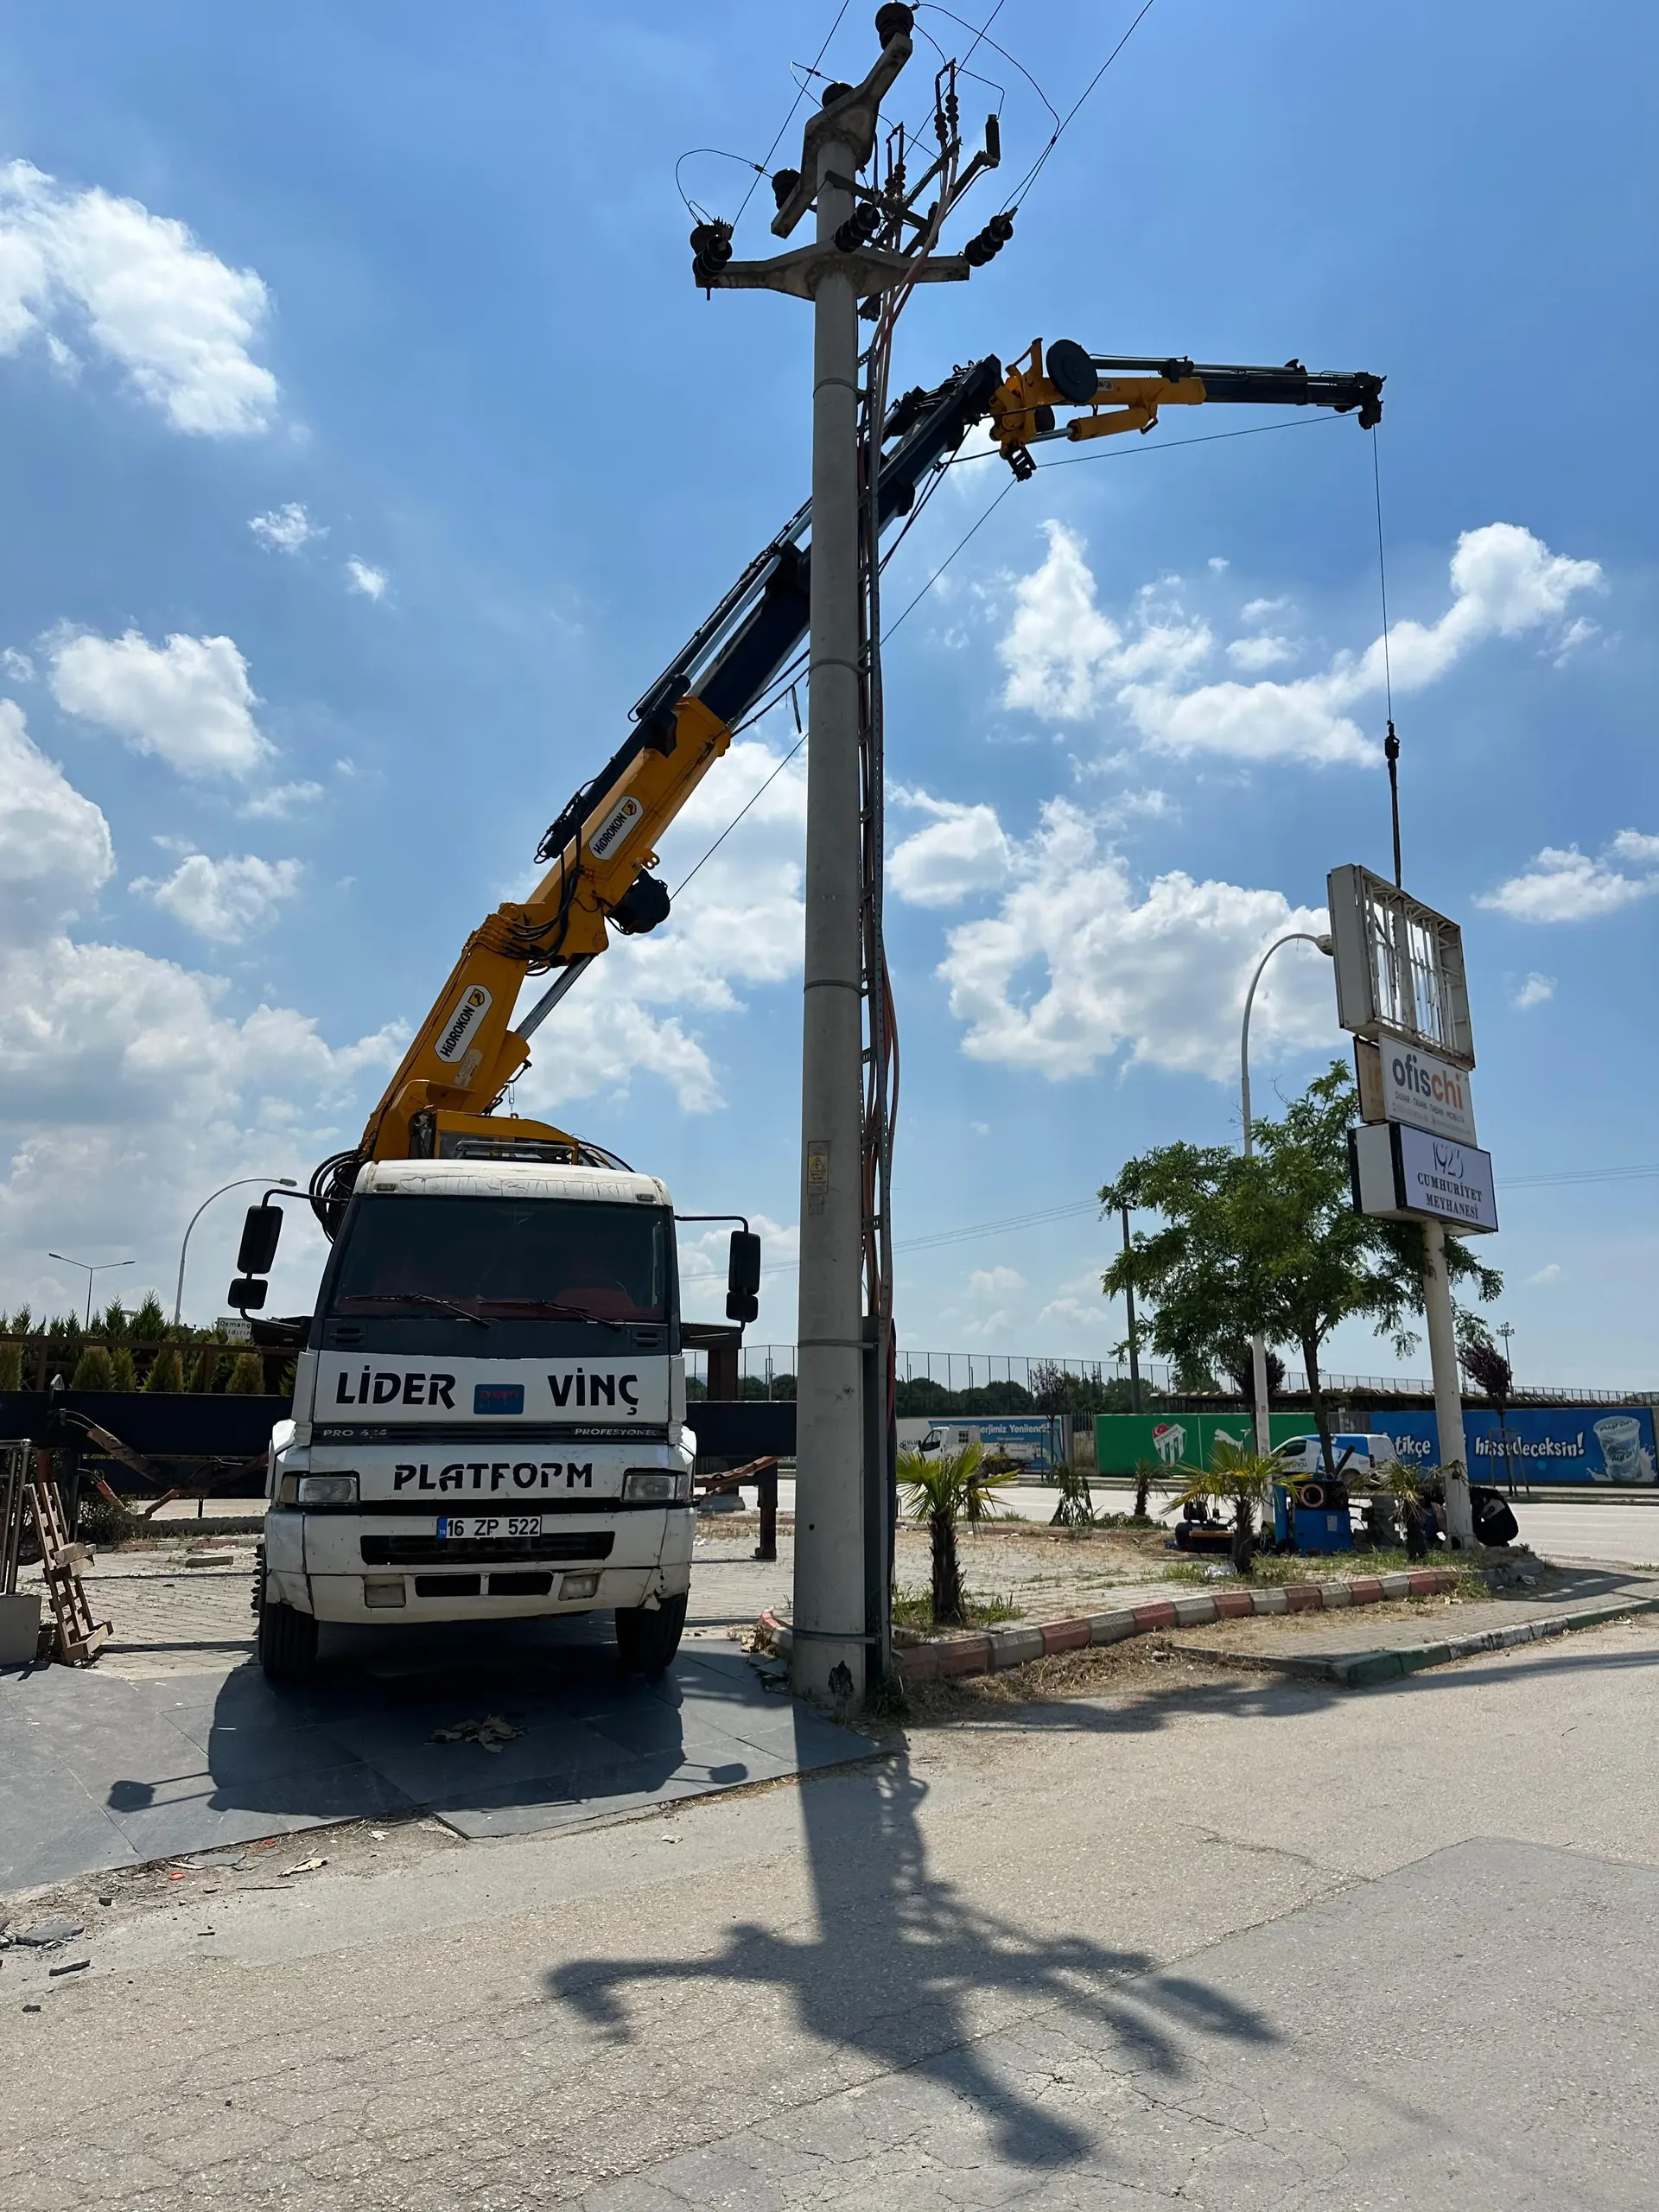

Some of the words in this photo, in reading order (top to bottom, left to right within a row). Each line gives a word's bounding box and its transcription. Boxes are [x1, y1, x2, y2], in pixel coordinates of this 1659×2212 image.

[1392, 1054, 1463, 1110] ofischi
[1417, 1172, 1483, 1203] CUMHURİYET
[1426, 1193, 1478, 1219] MEYHANESİ
[219, 1320, 251, 1329] Osmang
[335, 1364, 456, 1410] LİDER
[547, 1367, 639, 1415] VİNÇ
[980, 1424, 1007, 1435] erjimiz
[1395, 1435, 1431, 1458] tikçe
[448, 1519, 464, 1537] 16
[474, 1519, 499, 1536] ZP
[508, 1517, 539, 1535] 522
